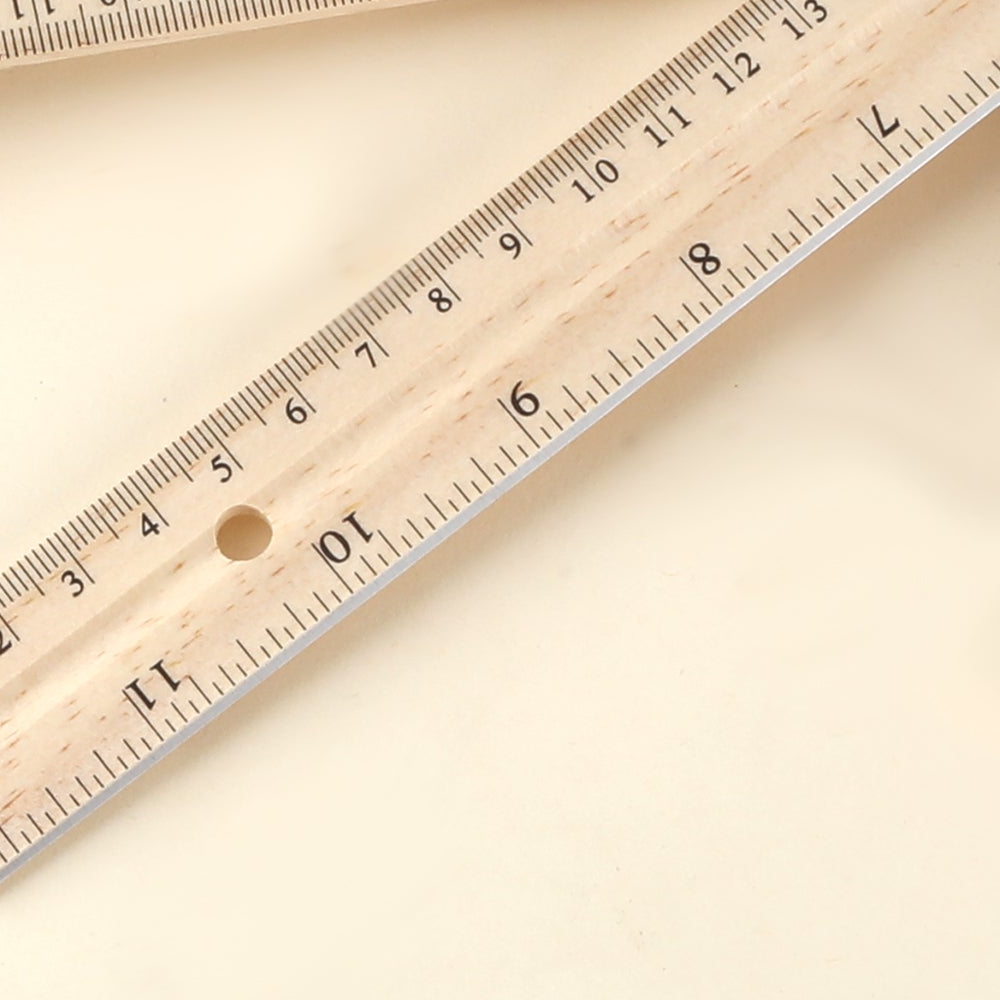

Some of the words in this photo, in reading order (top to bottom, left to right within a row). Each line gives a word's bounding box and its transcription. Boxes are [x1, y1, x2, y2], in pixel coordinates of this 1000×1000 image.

[870, 104, 900, 138] 7
[688, 241, 722, 275] 8
[61, 570, 84, 597] 3
[140, 513, 160, 539] 4
[211, 454, 233, 484] 5
[285, 397, 308, 425] 6
[354, 341, 379, 369] 7
[427, 287, 454, 313] 8
[498, 232, 522, 260] 9
[571, 158, 620, 204] 10
[643, 105, 692, 149] 11
[711, 51, 761, 95] 12
[510, 380, 541, 417] 9
[319, 510, 374, 564] 10
[125, 660, 182, 711] 11
